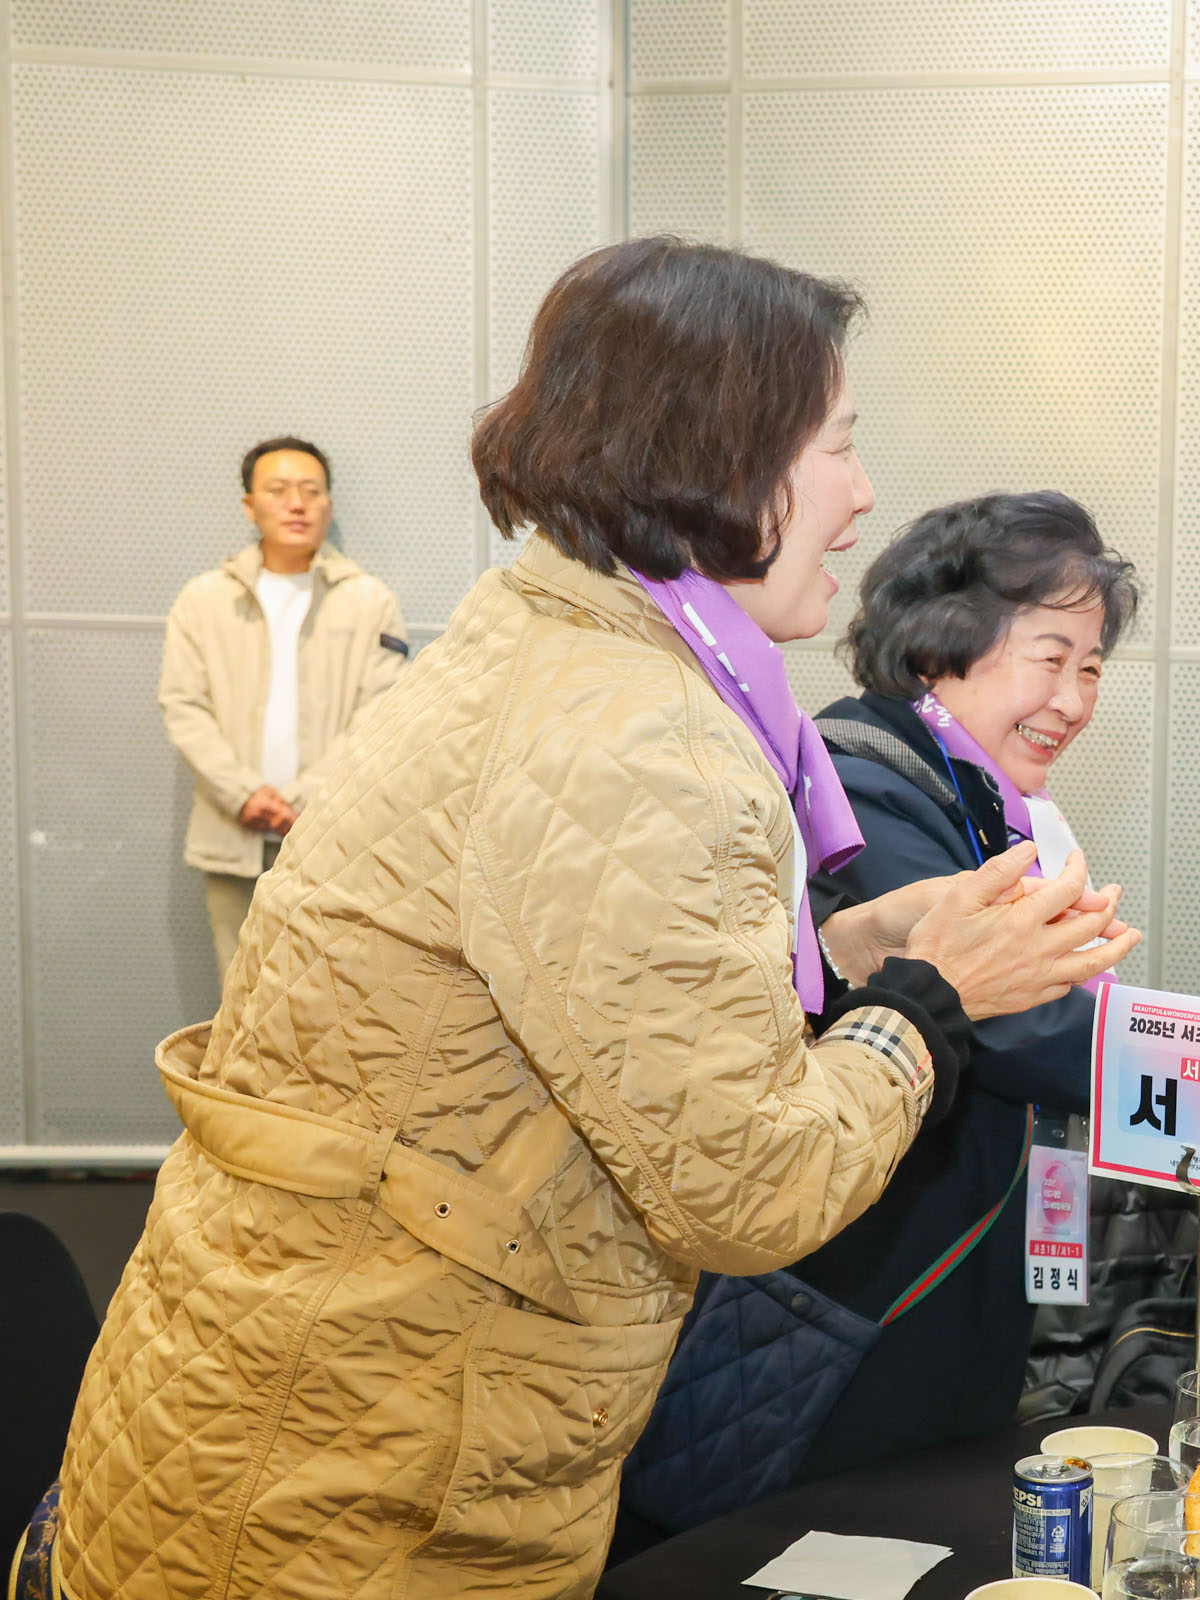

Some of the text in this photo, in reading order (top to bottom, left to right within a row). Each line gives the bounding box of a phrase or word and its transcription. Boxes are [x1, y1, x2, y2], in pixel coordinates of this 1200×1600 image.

[1129, 1017, 1176, 1039] 2025년
[1129, 1074, 1178, 1136] 서
[1013, 1487, 1042, 1507] EPSI
